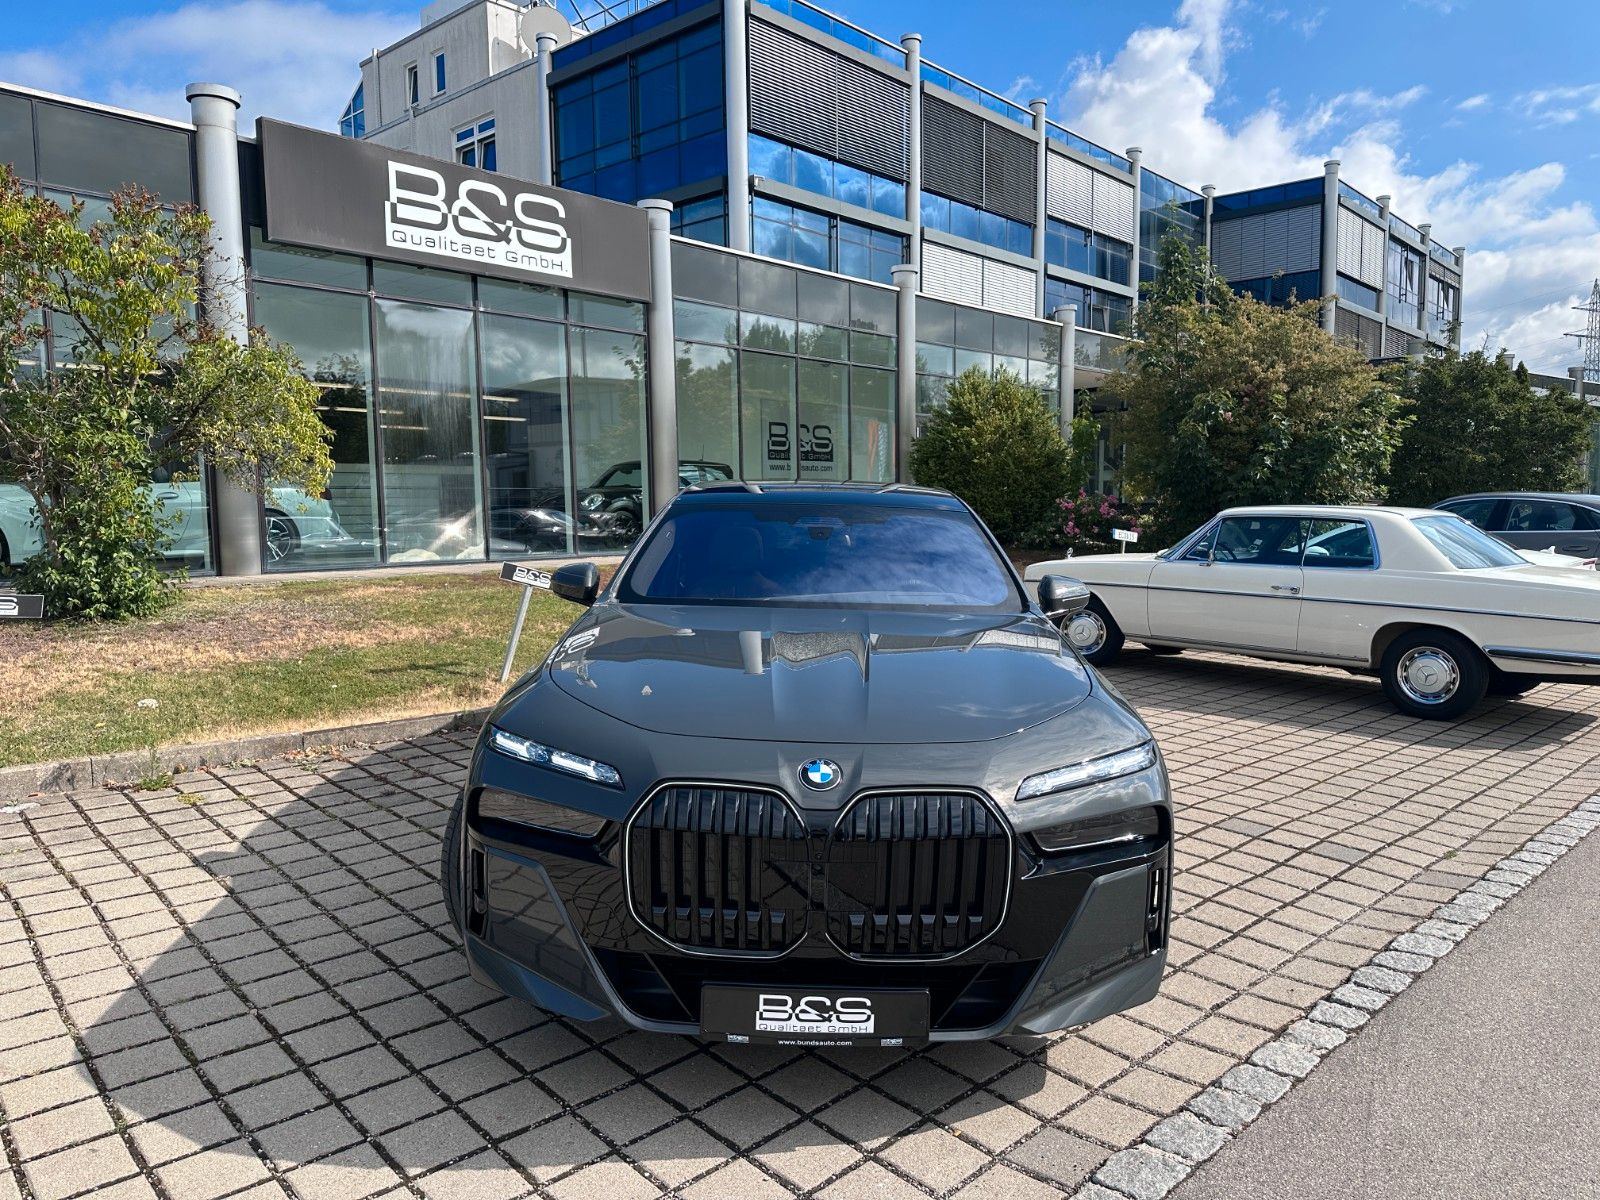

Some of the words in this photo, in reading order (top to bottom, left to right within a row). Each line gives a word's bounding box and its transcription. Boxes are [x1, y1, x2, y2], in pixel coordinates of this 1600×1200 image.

[388, 160, 567, 254] B&S
[392, 230, 495, 259] Qualitaet
[514, 567, 551, 585] B&S
[759, 994, 872, 1024] B&S
[759, 1023, 822, 1032] Qualitaet
